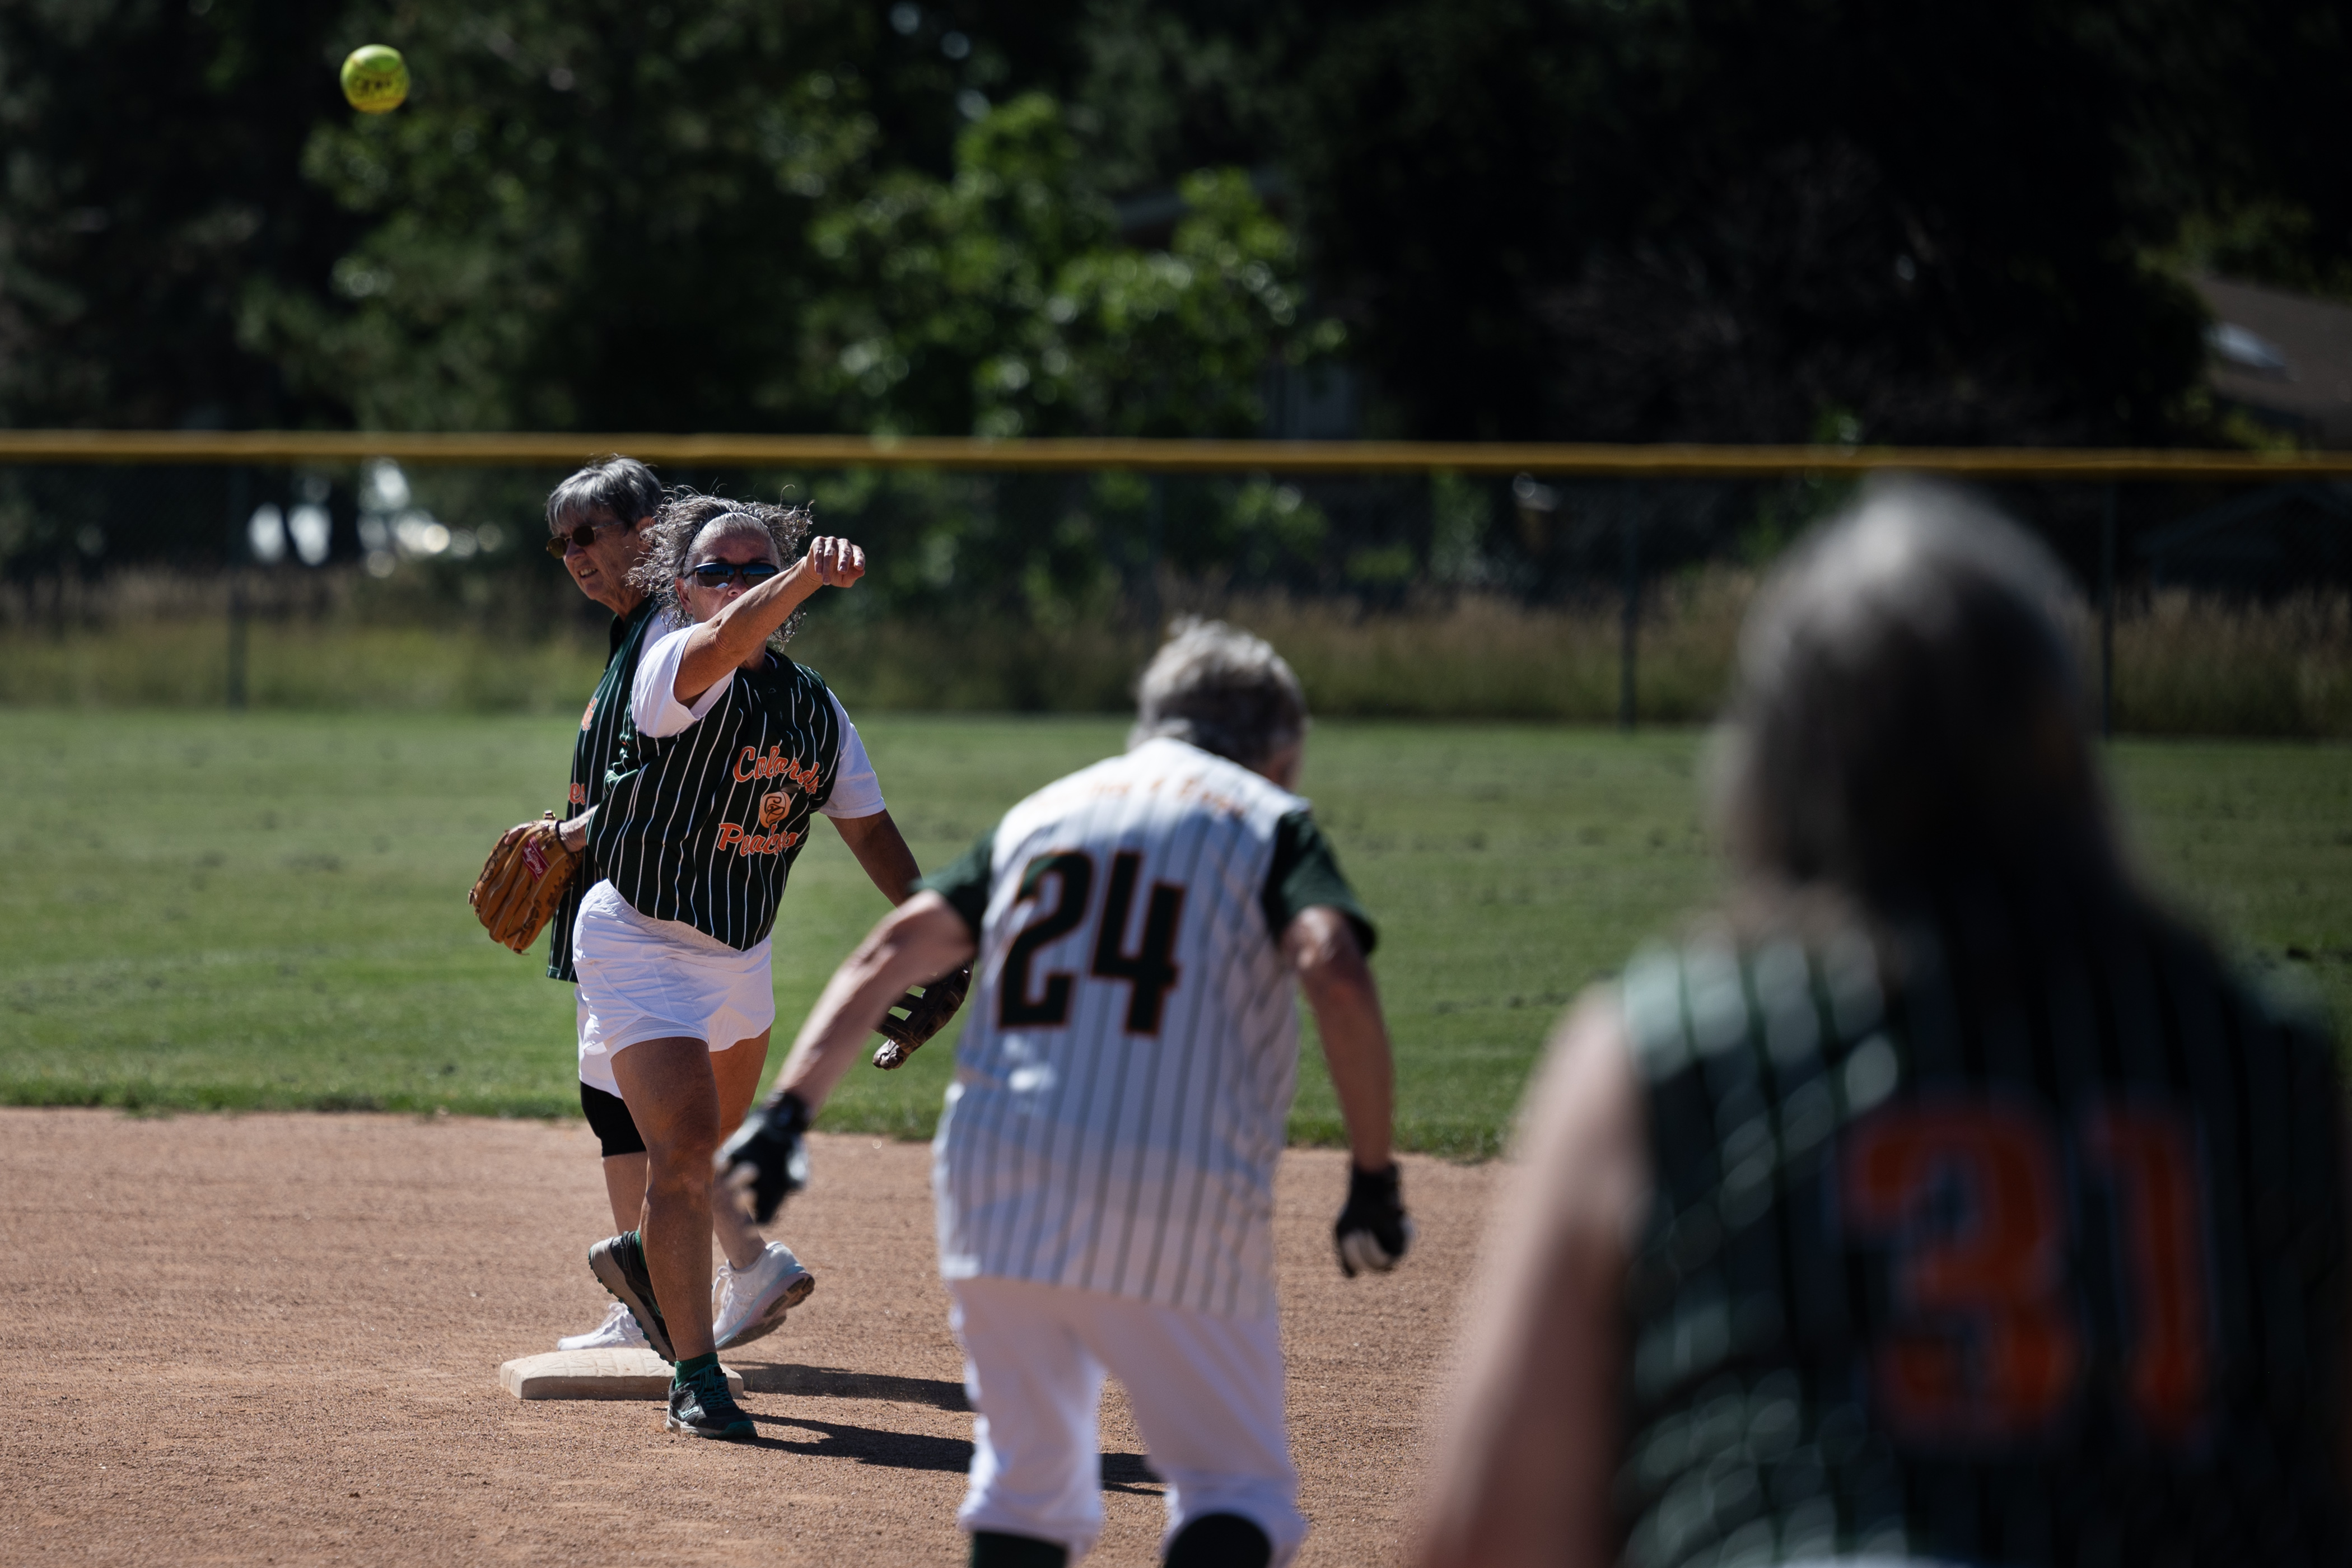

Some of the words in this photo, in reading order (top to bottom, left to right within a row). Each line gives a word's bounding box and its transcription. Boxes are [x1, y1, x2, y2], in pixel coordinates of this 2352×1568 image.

[732, 745, 819, 794] Colordo
[1000, 849, 1185, 1036] 24
[1842, 1099, 2212, 1452] 31
